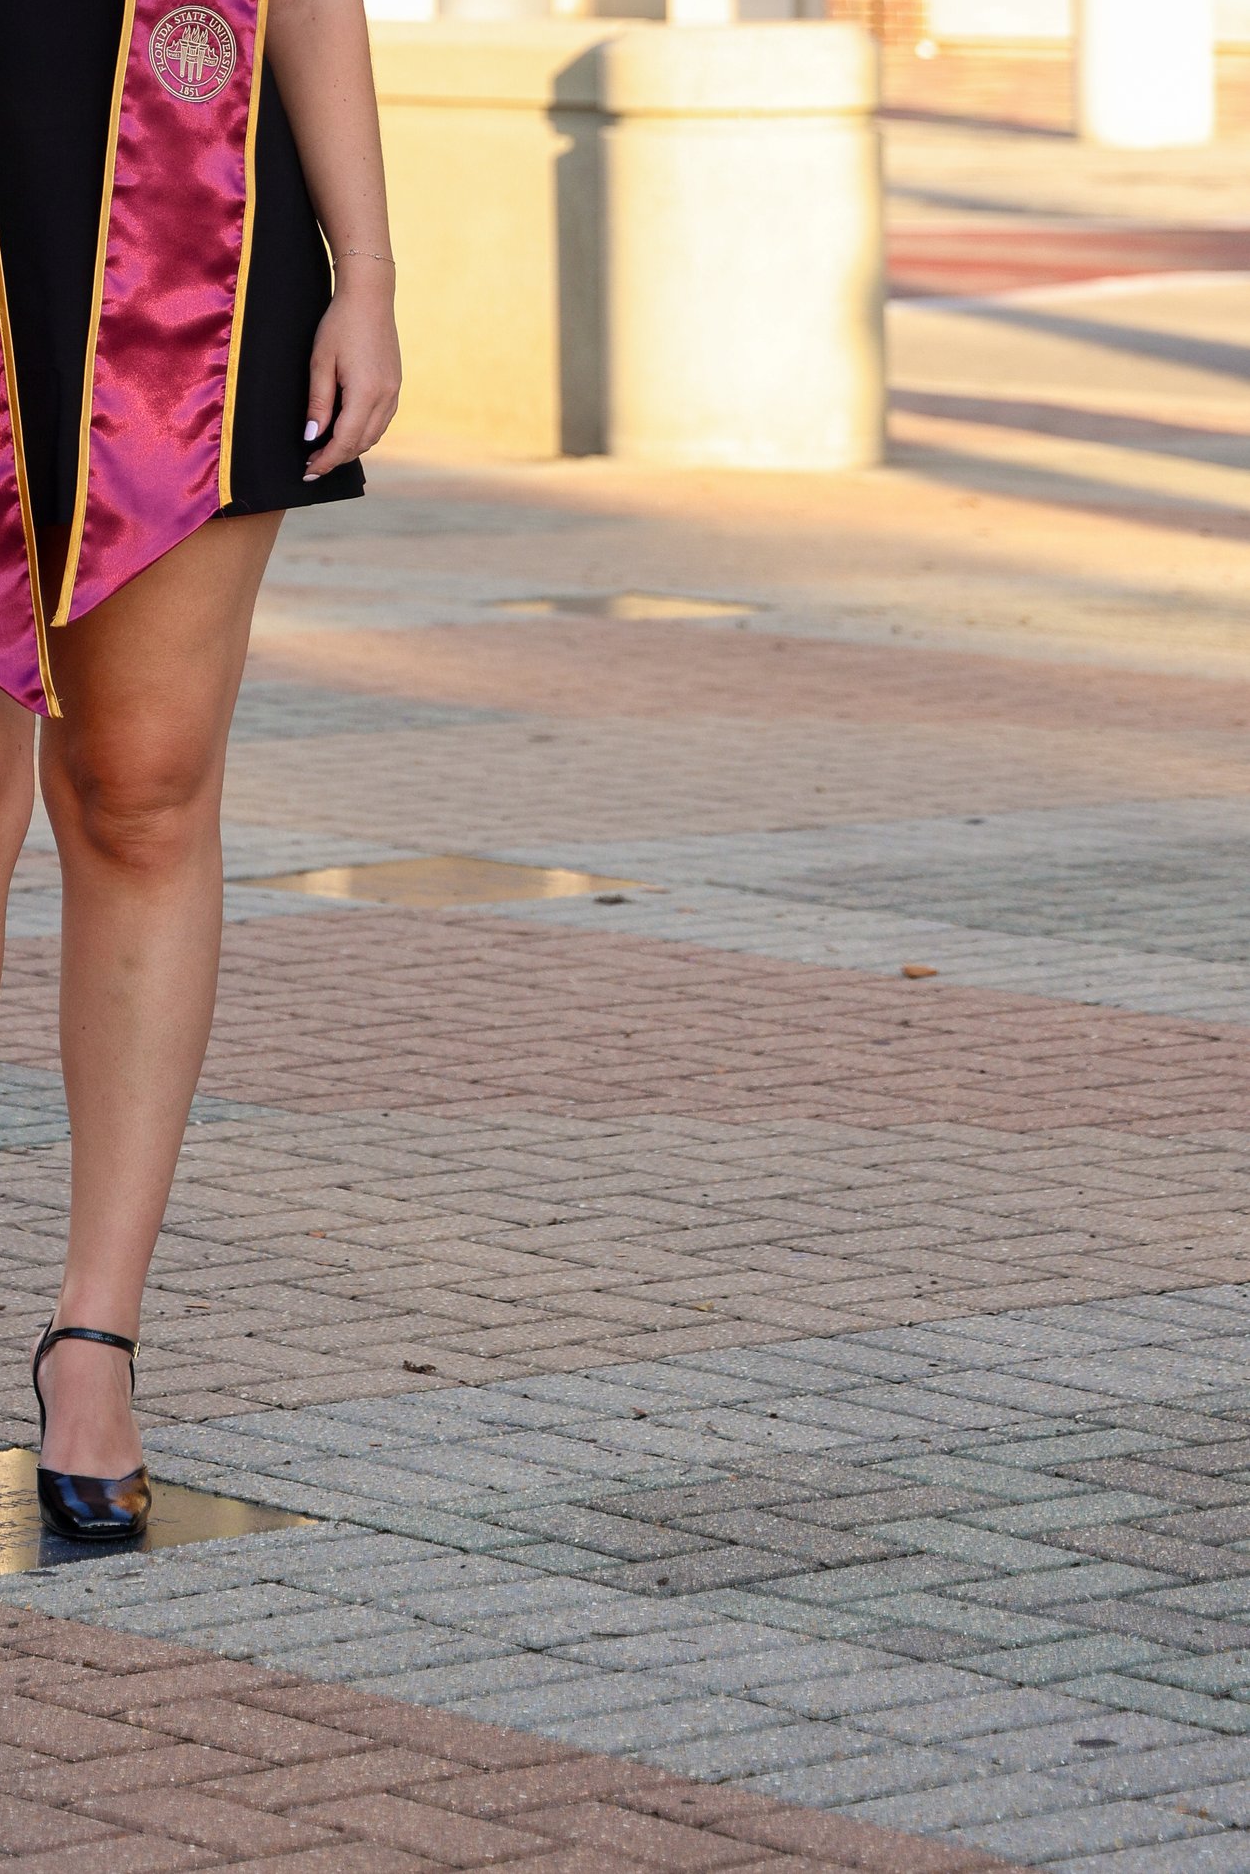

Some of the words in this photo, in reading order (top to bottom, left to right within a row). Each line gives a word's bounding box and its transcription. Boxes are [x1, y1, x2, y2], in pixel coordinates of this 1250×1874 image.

[154, 22, 174, 73] FLORIDA
[174, 11, 207, 24] STATE
[208, 18, 231, 85] UNIVERSITY
[179, 84, 200, 97] 1851
